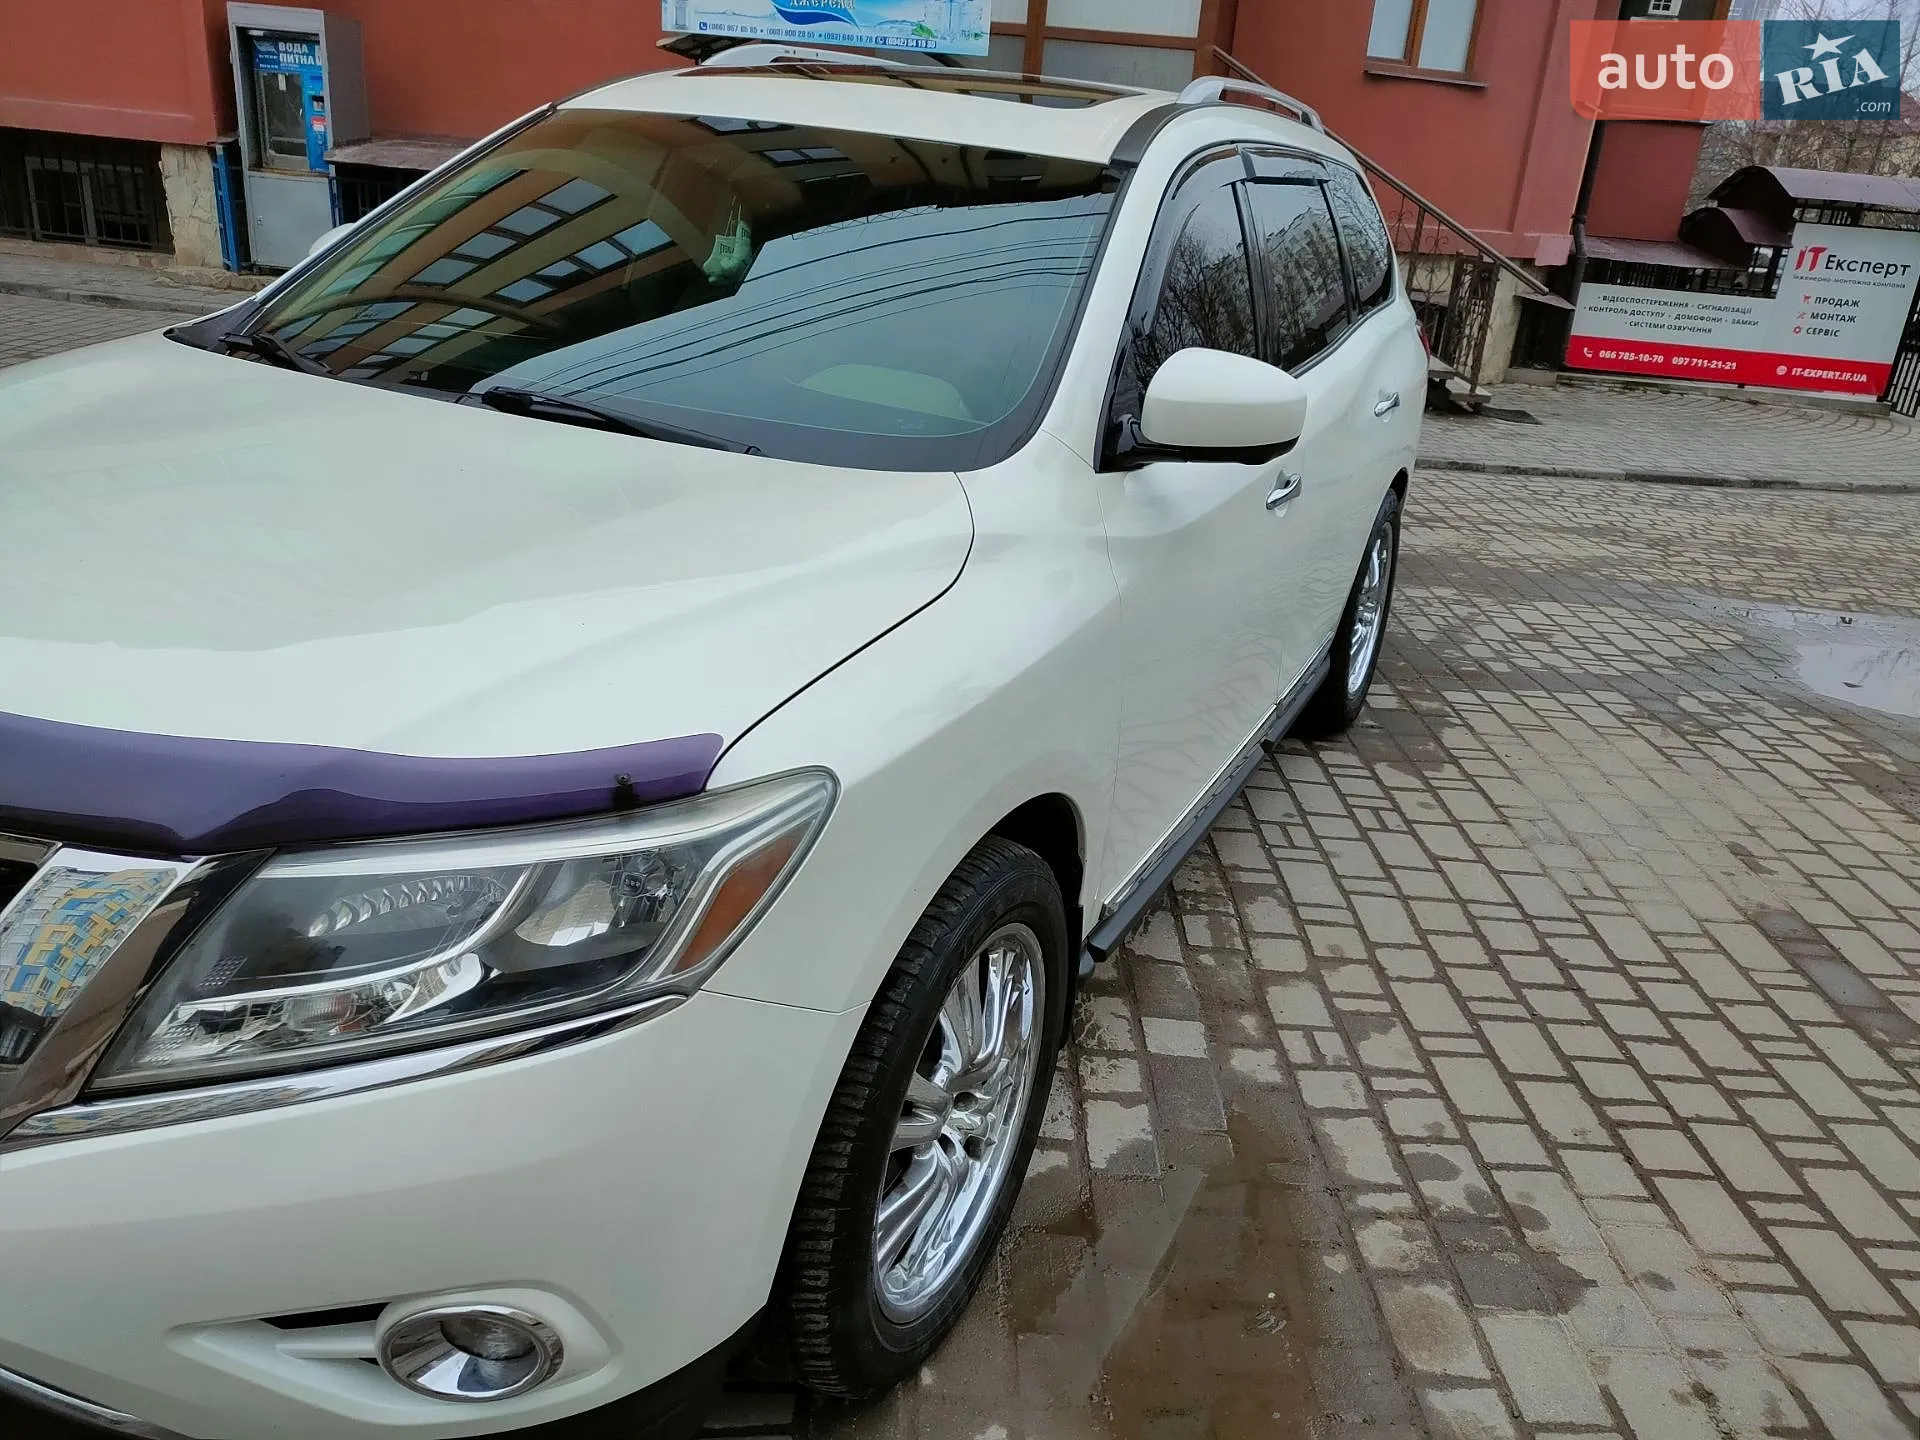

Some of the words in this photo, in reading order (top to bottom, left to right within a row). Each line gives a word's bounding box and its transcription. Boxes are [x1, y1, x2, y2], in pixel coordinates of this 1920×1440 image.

[278, 42, 309, 54] ВОДА
[279, 53, 315, 65] ПИТНА
[1825, 254, 1912, 279] Експерт
[1602, 294, 1689, 309] ВІДЕОСПОСТЕРЕЖЕННЯ
[1697, 303, 1752, 315] СИГНАЛІЗАЦІЇ
[1814, 296, 1861, 309] ПРОДАЖ
[1588, 305, 1628, 315] КОНТРОЛЬ
[1629, 309, 1666, 319] ДОСТУПУ
[1674, 313, 1723, 324] ДОМОФОНИ
[1731, 318, 1760, 328] ЗАМКИ
[1810, 311, 1857, 324] МОНТАЖ
[1629, 320, 1666, 330] СИСТЕМИ
[1666, 324, 1713, 335] ОЗВУЧЕННЯ
[1806, 326, 1841, 338] СЕРВІС
[1599, 350, 1617, 359] 066
[1618, 351, 1664, 364] 785-10-70
[1672, 356, 1690, 366] 097
[1691, 358, 1737, 370] 711-21-21
